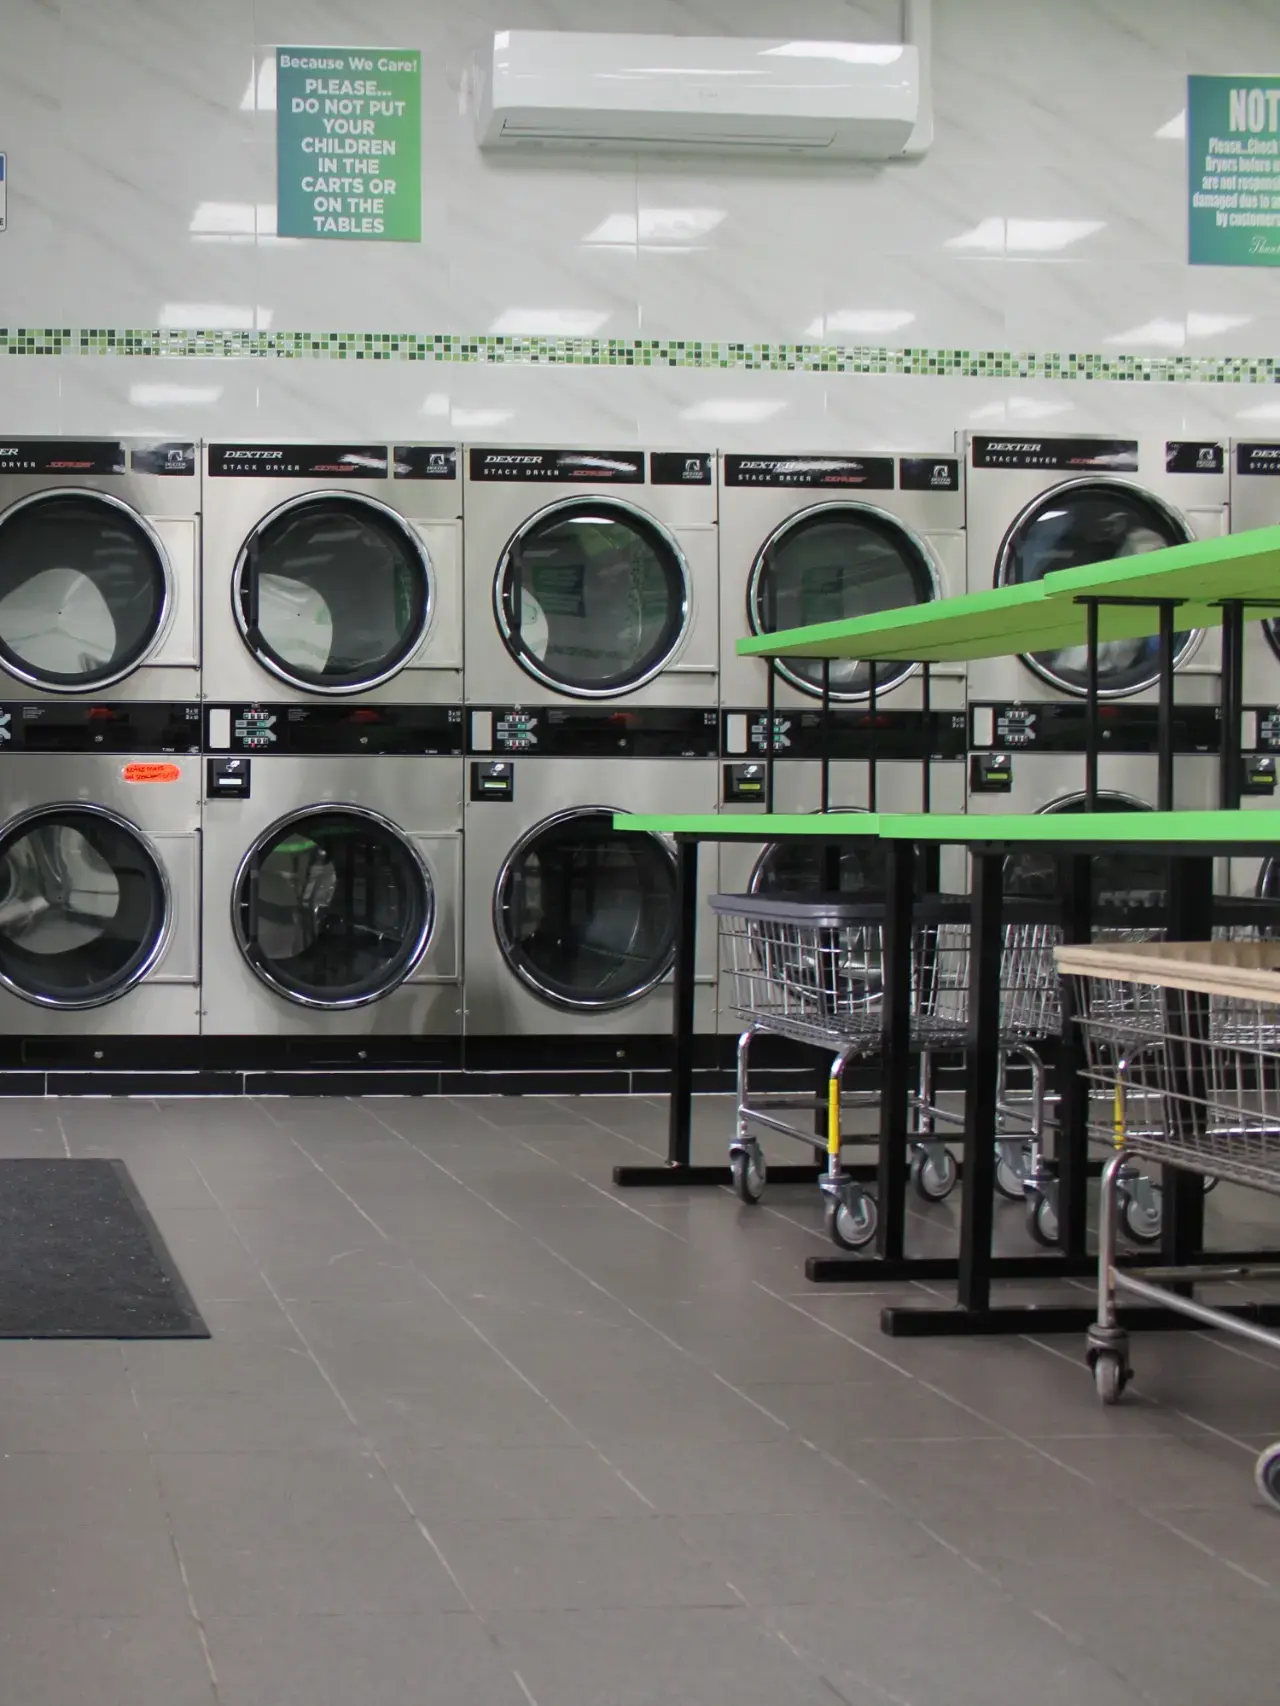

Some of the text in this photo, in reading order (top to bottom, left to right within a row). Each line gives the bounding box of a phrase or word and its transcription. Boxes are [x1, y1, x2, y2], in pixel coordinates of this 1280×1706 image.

[280, 55, 418, 72] Because We Care!
[305, 79, 392, 96] PLEASE...
[292, 98, 406, 116] DO NOT PUT
[322, 118, 375, 135] YOUR
[301, 138, 396, 155] CHILDREN
[318, 158, 379, 174] IN THE
[1205, 156, 1238, 173] Dryers
[1239, 156, 1271, 172] before
[301, 177, 396, 194] CARTS OR
[1202, 176, 1219, 190] are
[1220, 175, 1236, 190] not
[314, 197, 384, 214] ON THE
[1193, 192, 1238, 209] damaged
[1239, 193, 1258, 208] due
[1260, 195, 1270, 208] to
[313, 216, 384, 233] TABLES
[1216, 210, 1228, 228] by
[223, 451, 283, 459] DEXTER
[986, 442, 1042, 451] DEXTER
[484, 455, 543, 464] DEXTER
